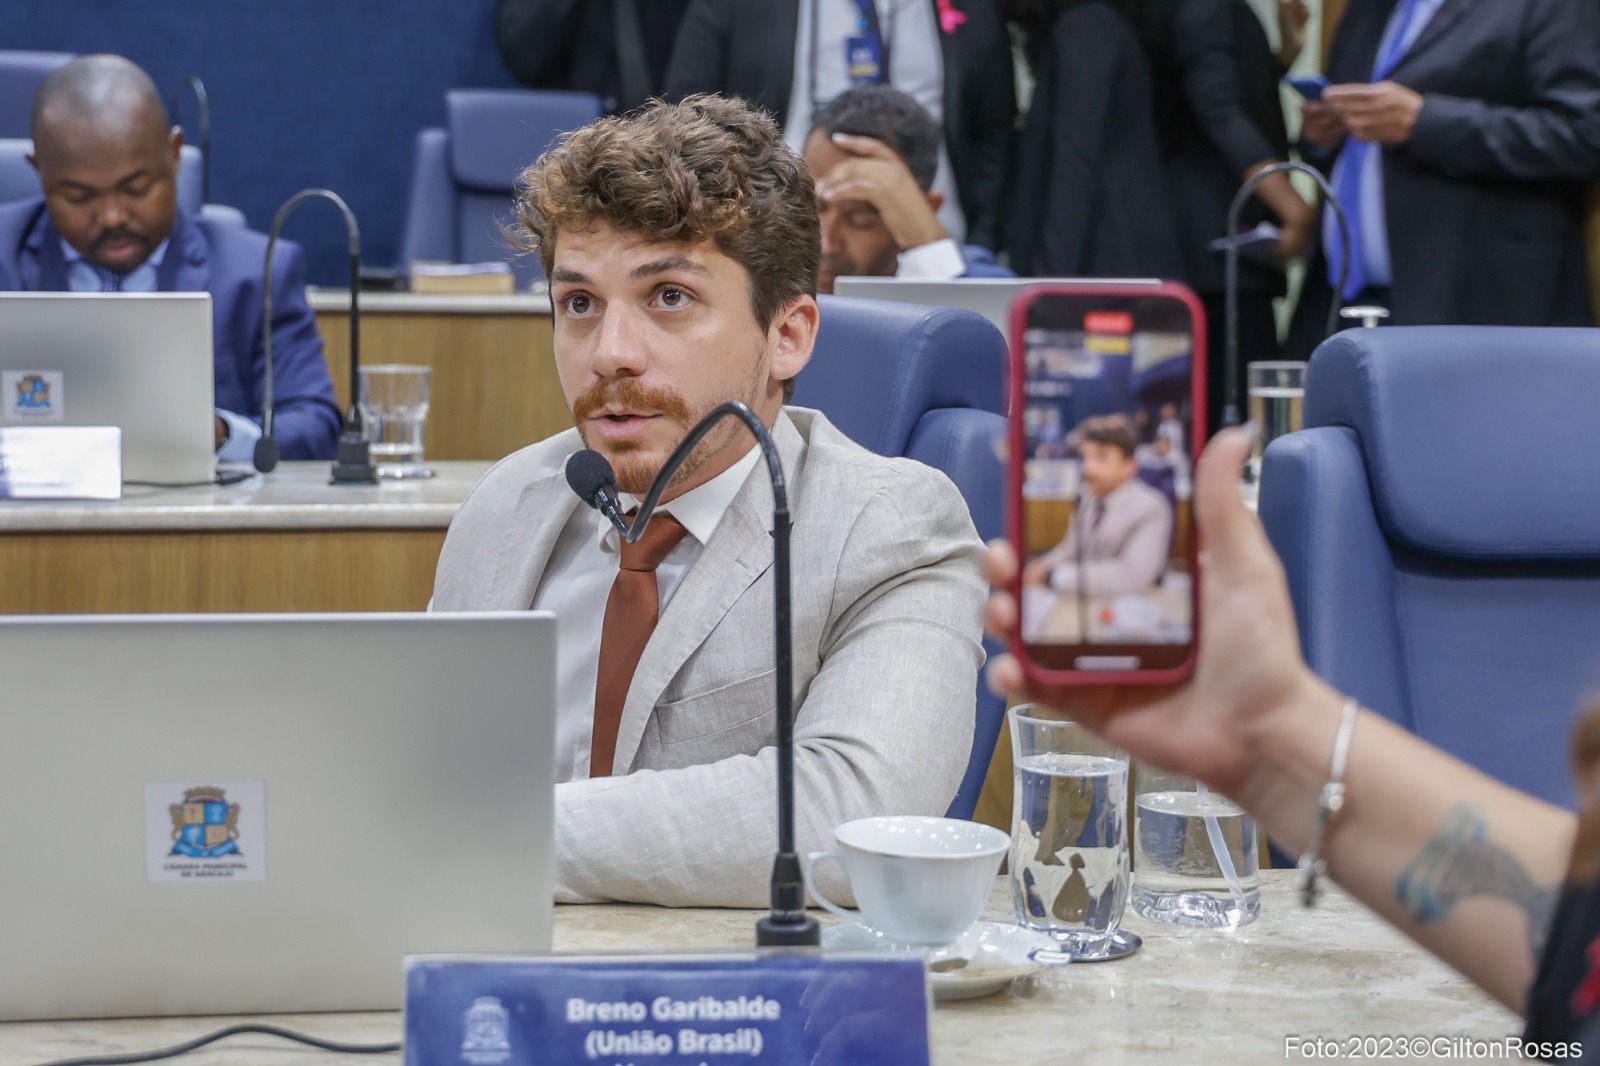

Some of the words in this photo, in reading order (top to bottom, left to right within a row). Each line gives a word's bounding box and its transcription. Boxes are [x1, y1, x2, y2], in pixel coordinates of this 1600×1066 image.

[566, 998, 648, 1022] Breno
[652, 996, 781, 1021] Garibalde
[585, 1030, 673, 1058] (União
[678, 1027, 763, 1055] Brasil)
